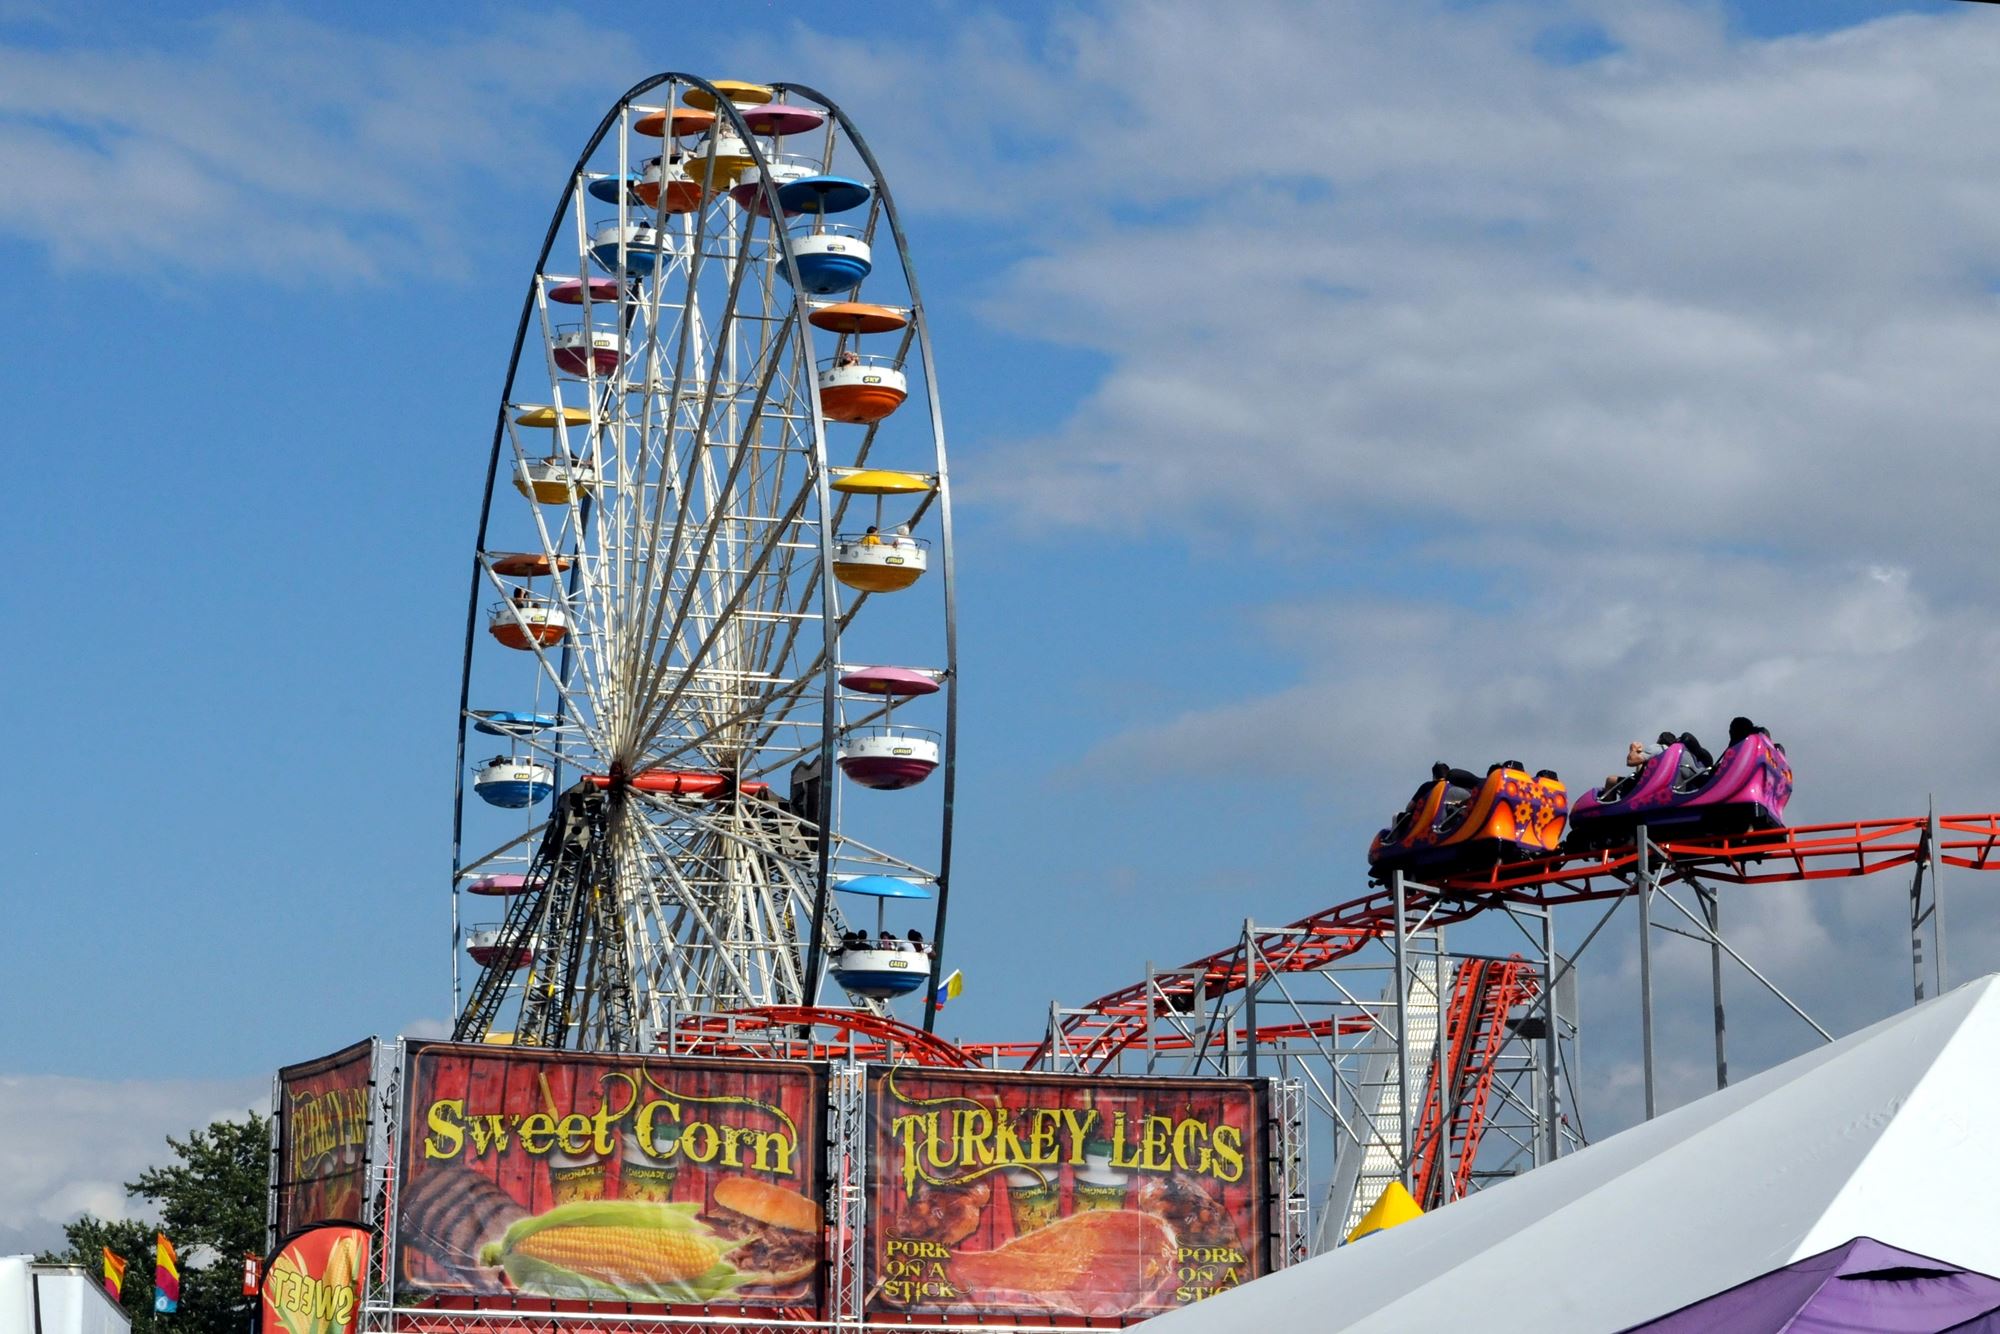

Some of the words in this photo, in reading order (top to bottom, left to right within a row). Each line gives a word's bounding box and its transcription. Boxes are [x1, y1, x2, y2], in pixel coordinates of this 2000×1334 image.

[863, 376, 881, 384] SKY
[424, 1072, 638, 1159] Sweet
[634, 1057, 798, 1175] Corn
[889, 1064, 1100, 1199] TURKEY
[1108, 1104, 1244, 1182] LEGS
[555, 1166, 595, 1181] LEMONADE
[625, 1167, 665, 1179] LEMONADE
[1078, 1183, 1116, 1196] LEMONADE
[886, 1240, 951, 1258] PORK
[1177, 1248, 1245, 1263] PORK
[886, 1258, 926, 1280] ON
[928, 1262, 948, 1281] A
[1177, 1265, 1218, 1285] ON
[1223, 1267, 1239, 1286] A
[884, 1281, 956, 1303] STICK
